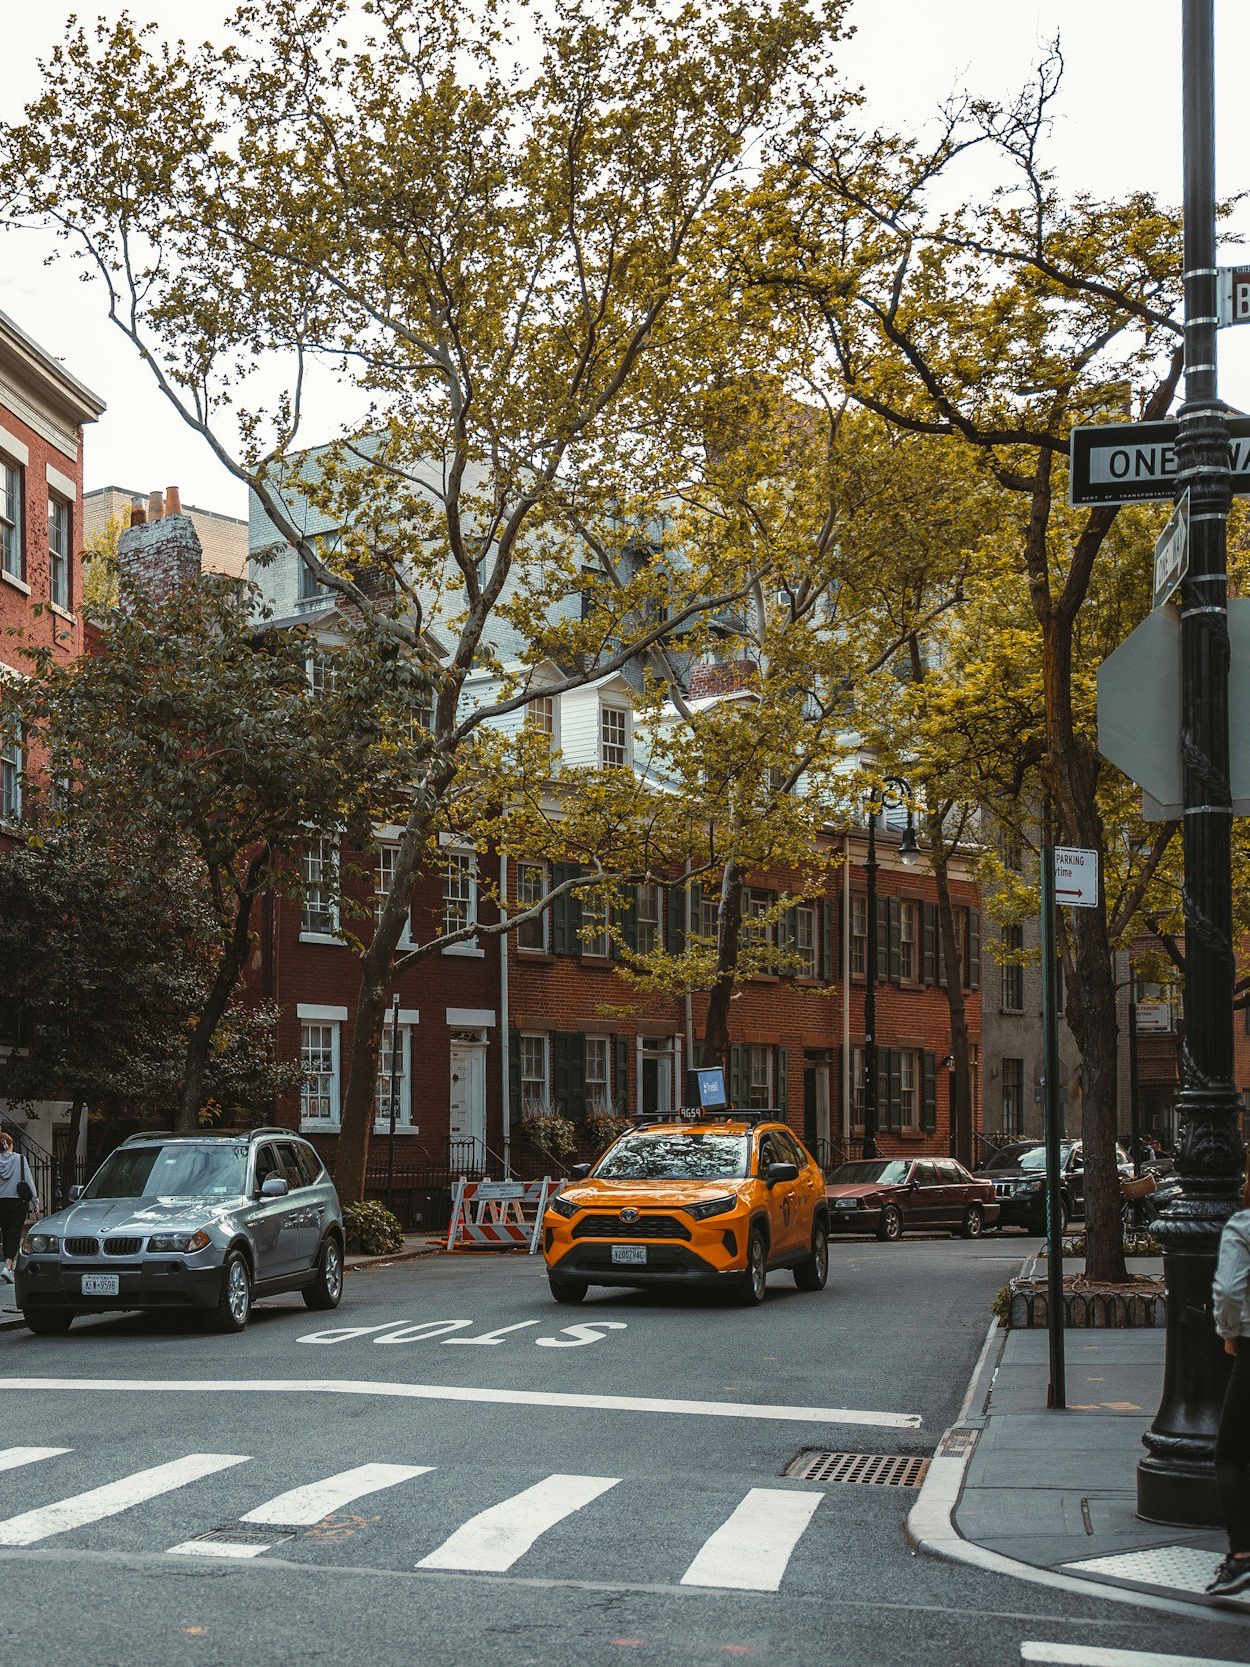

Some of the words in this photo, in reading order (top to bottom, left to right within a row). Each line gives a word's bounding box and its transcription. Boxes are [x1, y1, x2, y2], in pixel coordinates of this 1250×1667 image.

[1109, 447, 1179, 479] ONE
[1119, 490, 1177, 499] TRANSPORTATION
[1056, 853, 1085, 866] PARKING
[1055, 866, 1073, 878] time
[295, 1319, 628, 1348] STOP
